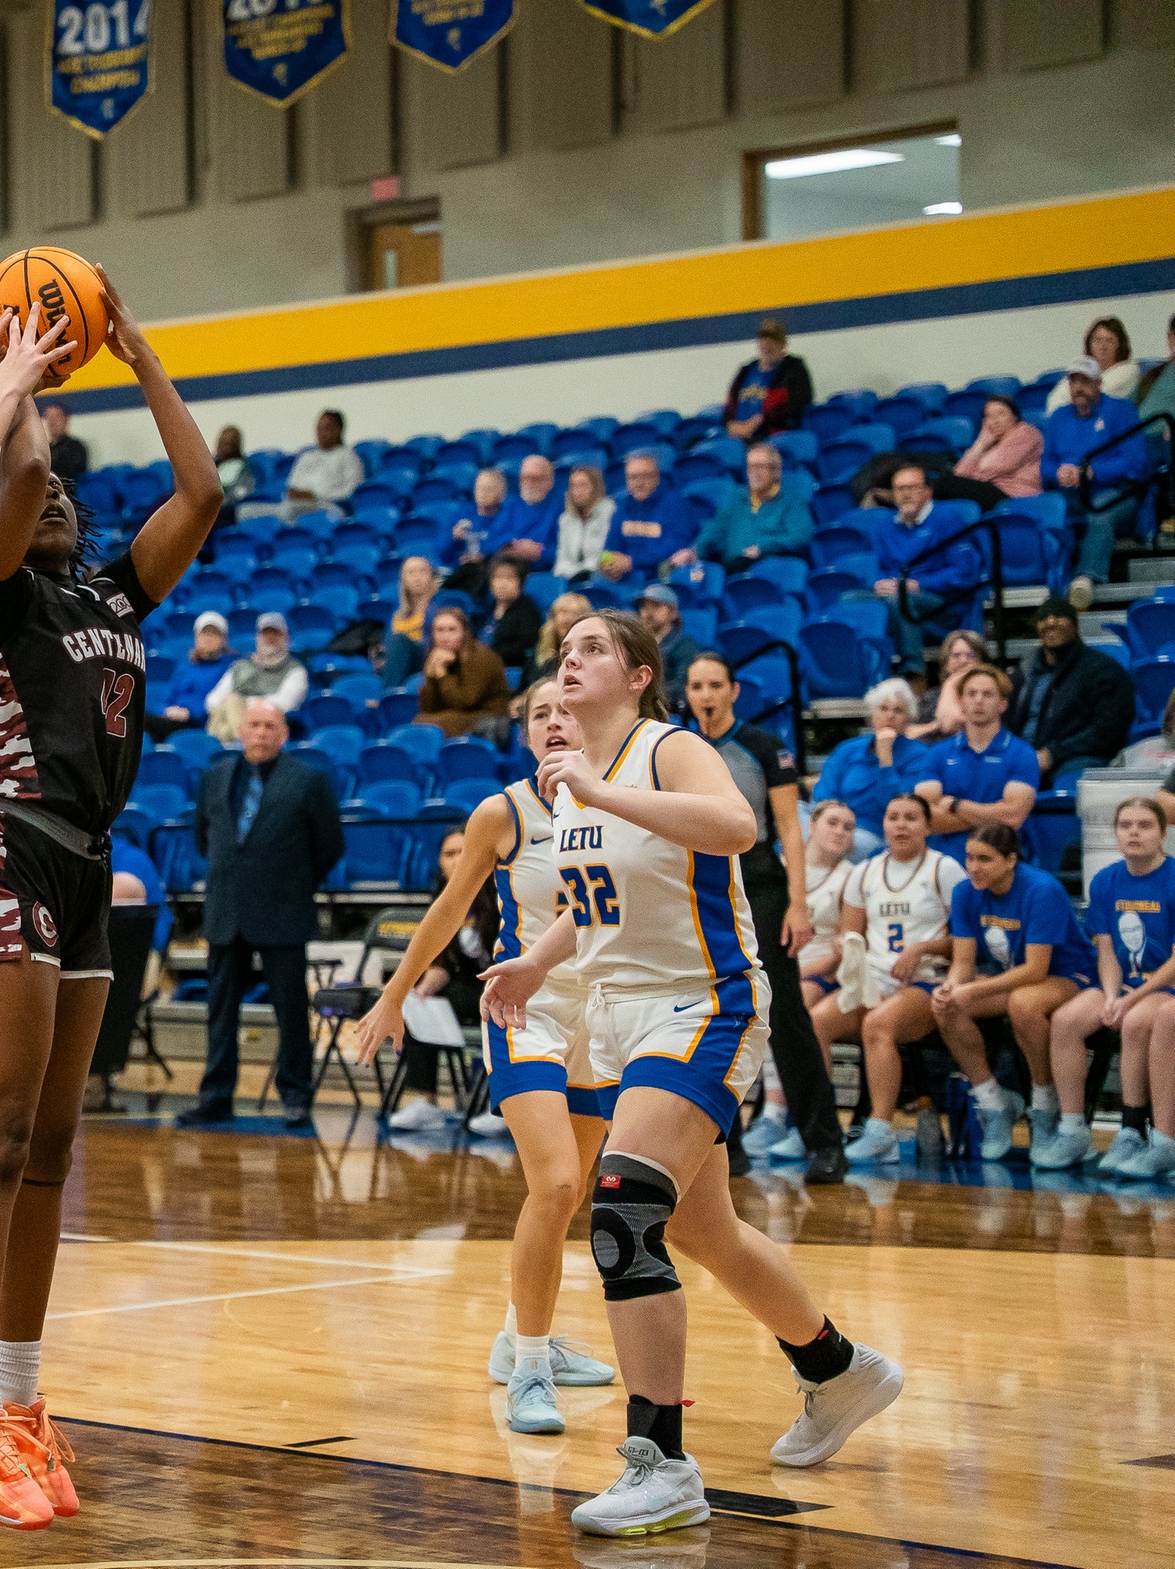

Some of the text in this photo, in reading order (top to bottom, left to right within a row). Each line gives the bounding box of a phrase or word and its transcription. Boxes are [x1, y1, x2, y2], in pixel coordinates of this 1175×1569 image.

[100, 667, 135, 738] 12
[559, 825, 604, 852] LETU
[558, 863, 621, 929] 32
[879, 902, 911, 917] LETU
[887, 923, 904, 953] 2
